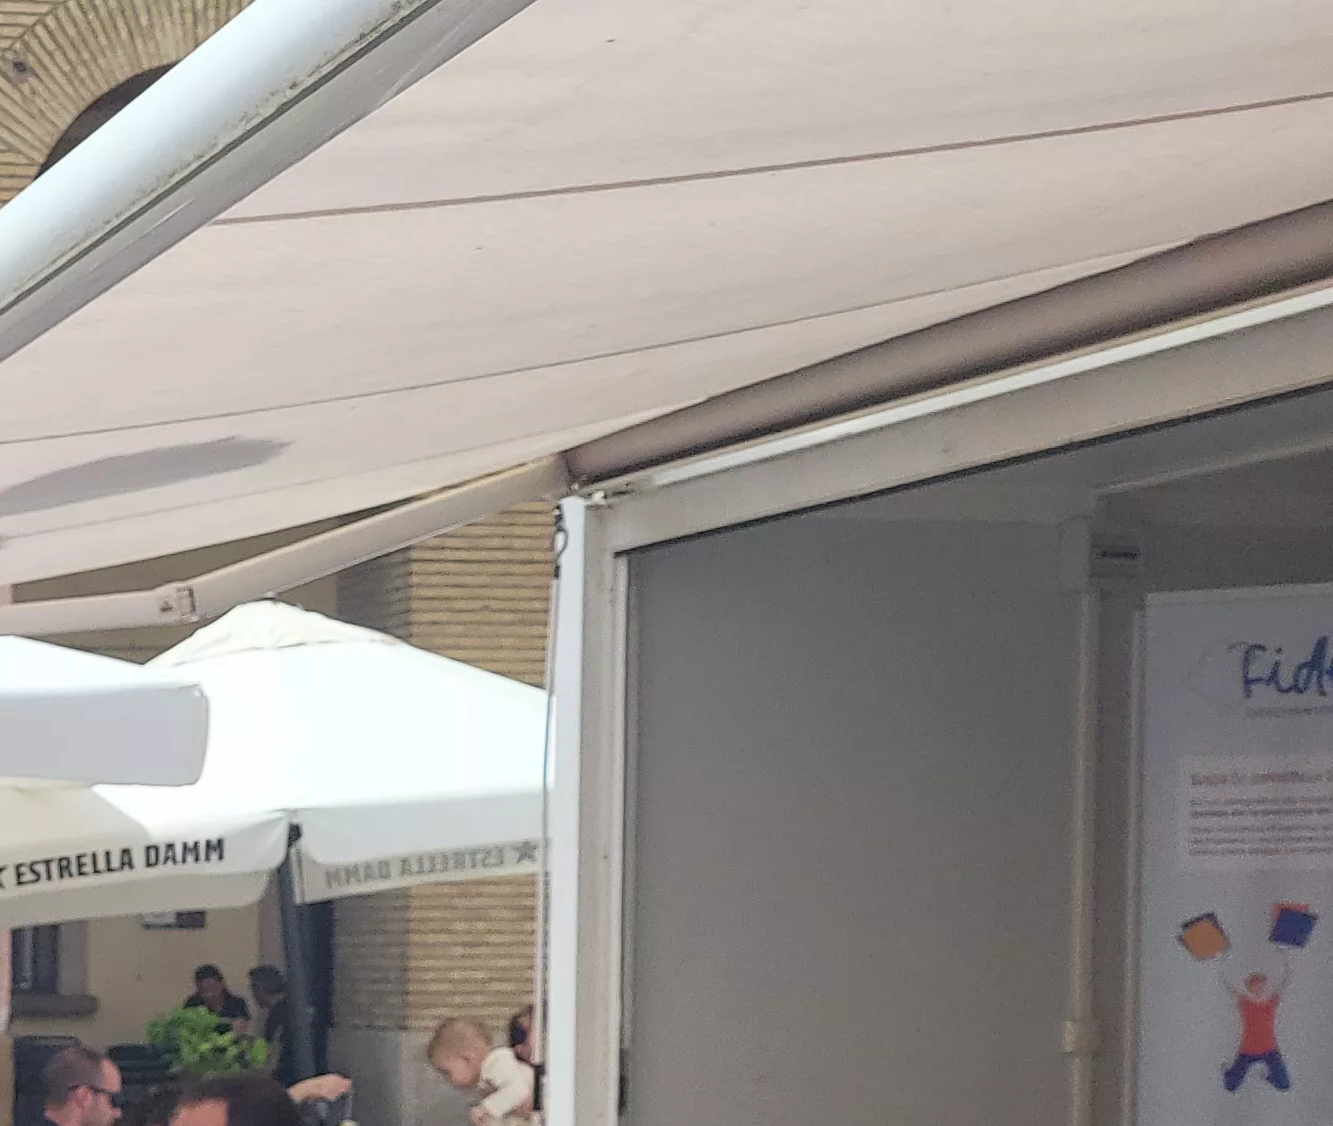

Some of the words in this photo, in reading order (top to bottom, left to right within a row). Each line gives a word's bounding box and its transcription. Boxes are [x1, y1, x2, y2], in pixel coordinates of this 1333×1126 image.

[1242, 636, 1333, 698] Fid
[14, 848, 134, 886] ESTRELLA
[144, 837, 226, 868] DAMM
